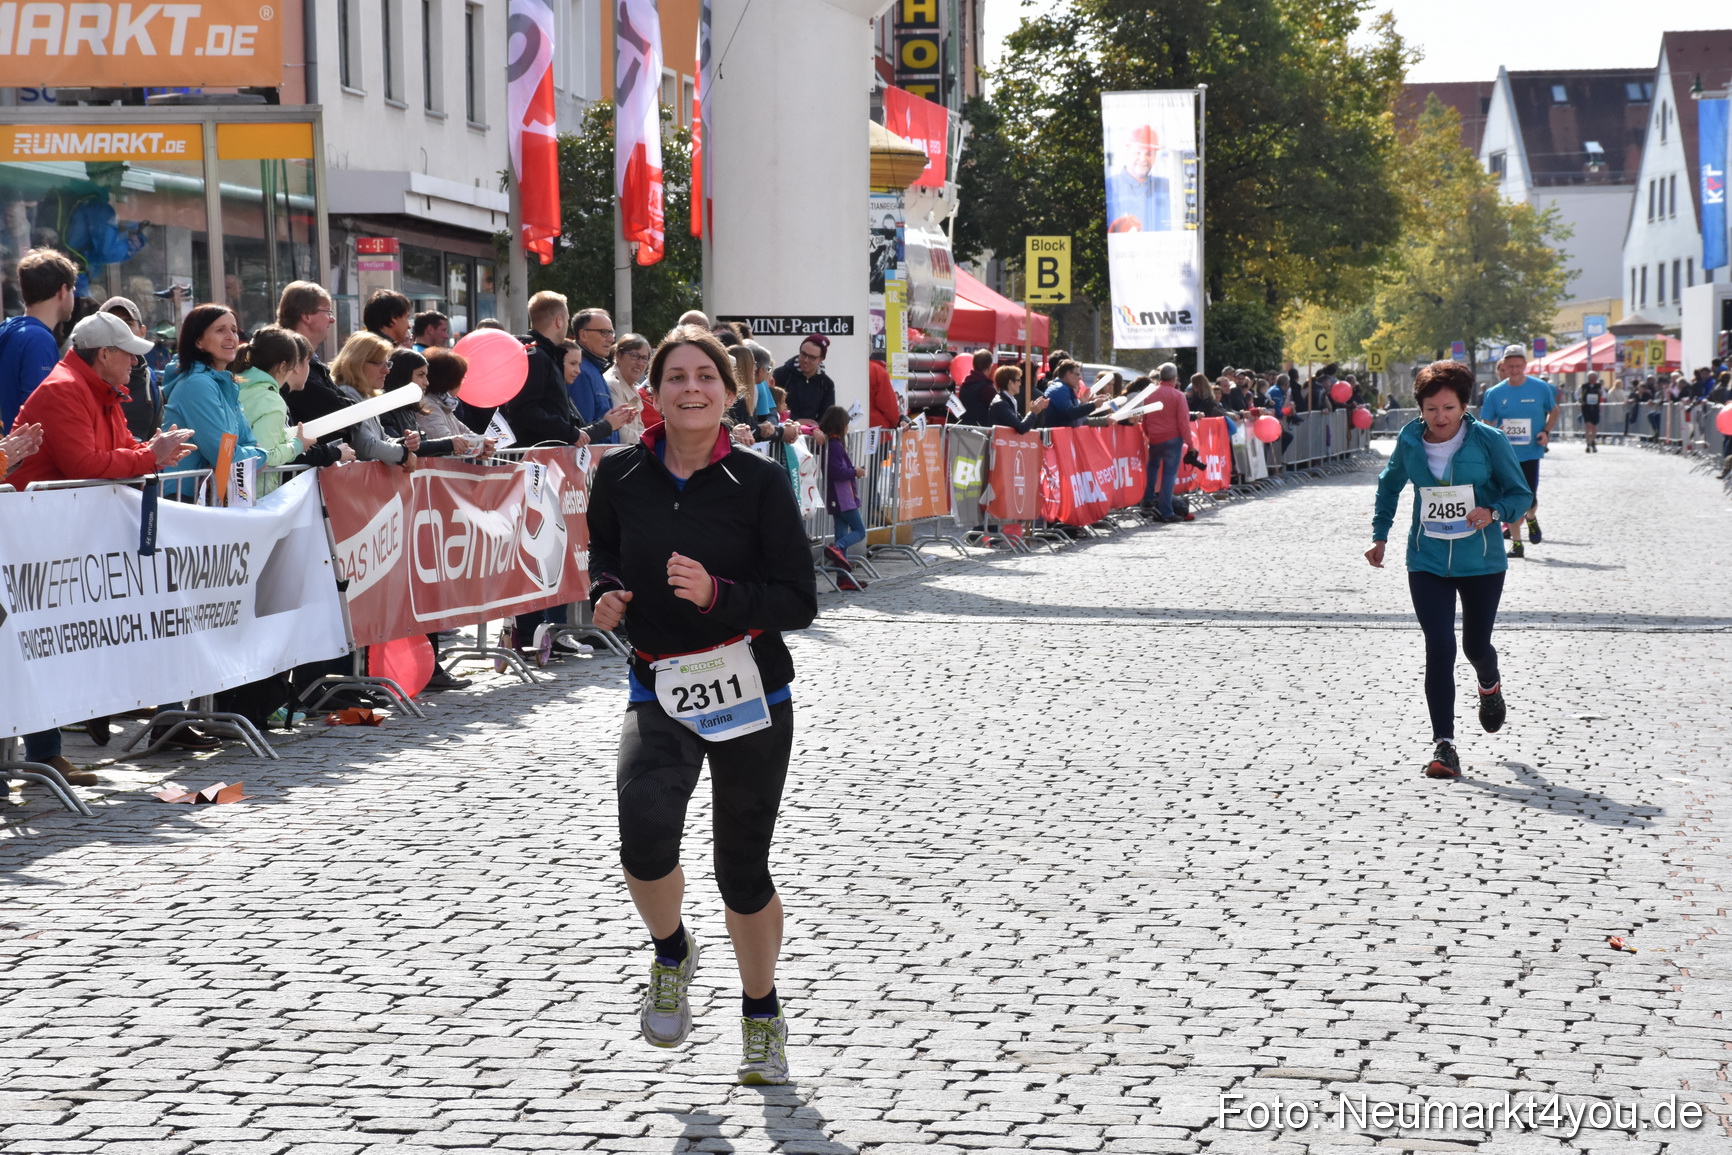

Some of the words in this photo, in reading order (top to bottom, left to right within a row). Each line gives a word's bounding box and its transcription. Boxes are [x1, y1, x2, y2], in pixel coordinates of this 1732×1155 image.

[0, 3, 258, 56] ARKT.DE
[12, 132, 186, 154] RUNMARKT.DE
[1031, 239, 1066, 251] Block
[1038, 256, 1060, 288] B
[745, 318, 848, 333] MINI-Partl.de
[1315, 333, 1328, 352] C
[1371, 353, 1381, 366] D
[1652, 347, 1663, 361] D
[1507, 426, 1526, 435] 2334
[236, 462, 244, 488] swn
[1428, 502, 1467, 519] 2485
[372, 511, 399, 571] NEUE
[2, 561, 48, 614] BMW
[54, 613, 148, 655] VERBRAUCH.
[689, 657, 724, 673] BOCK
[671, 673, 743, 713] 2311
[700, 713, 733, 729] Karina
